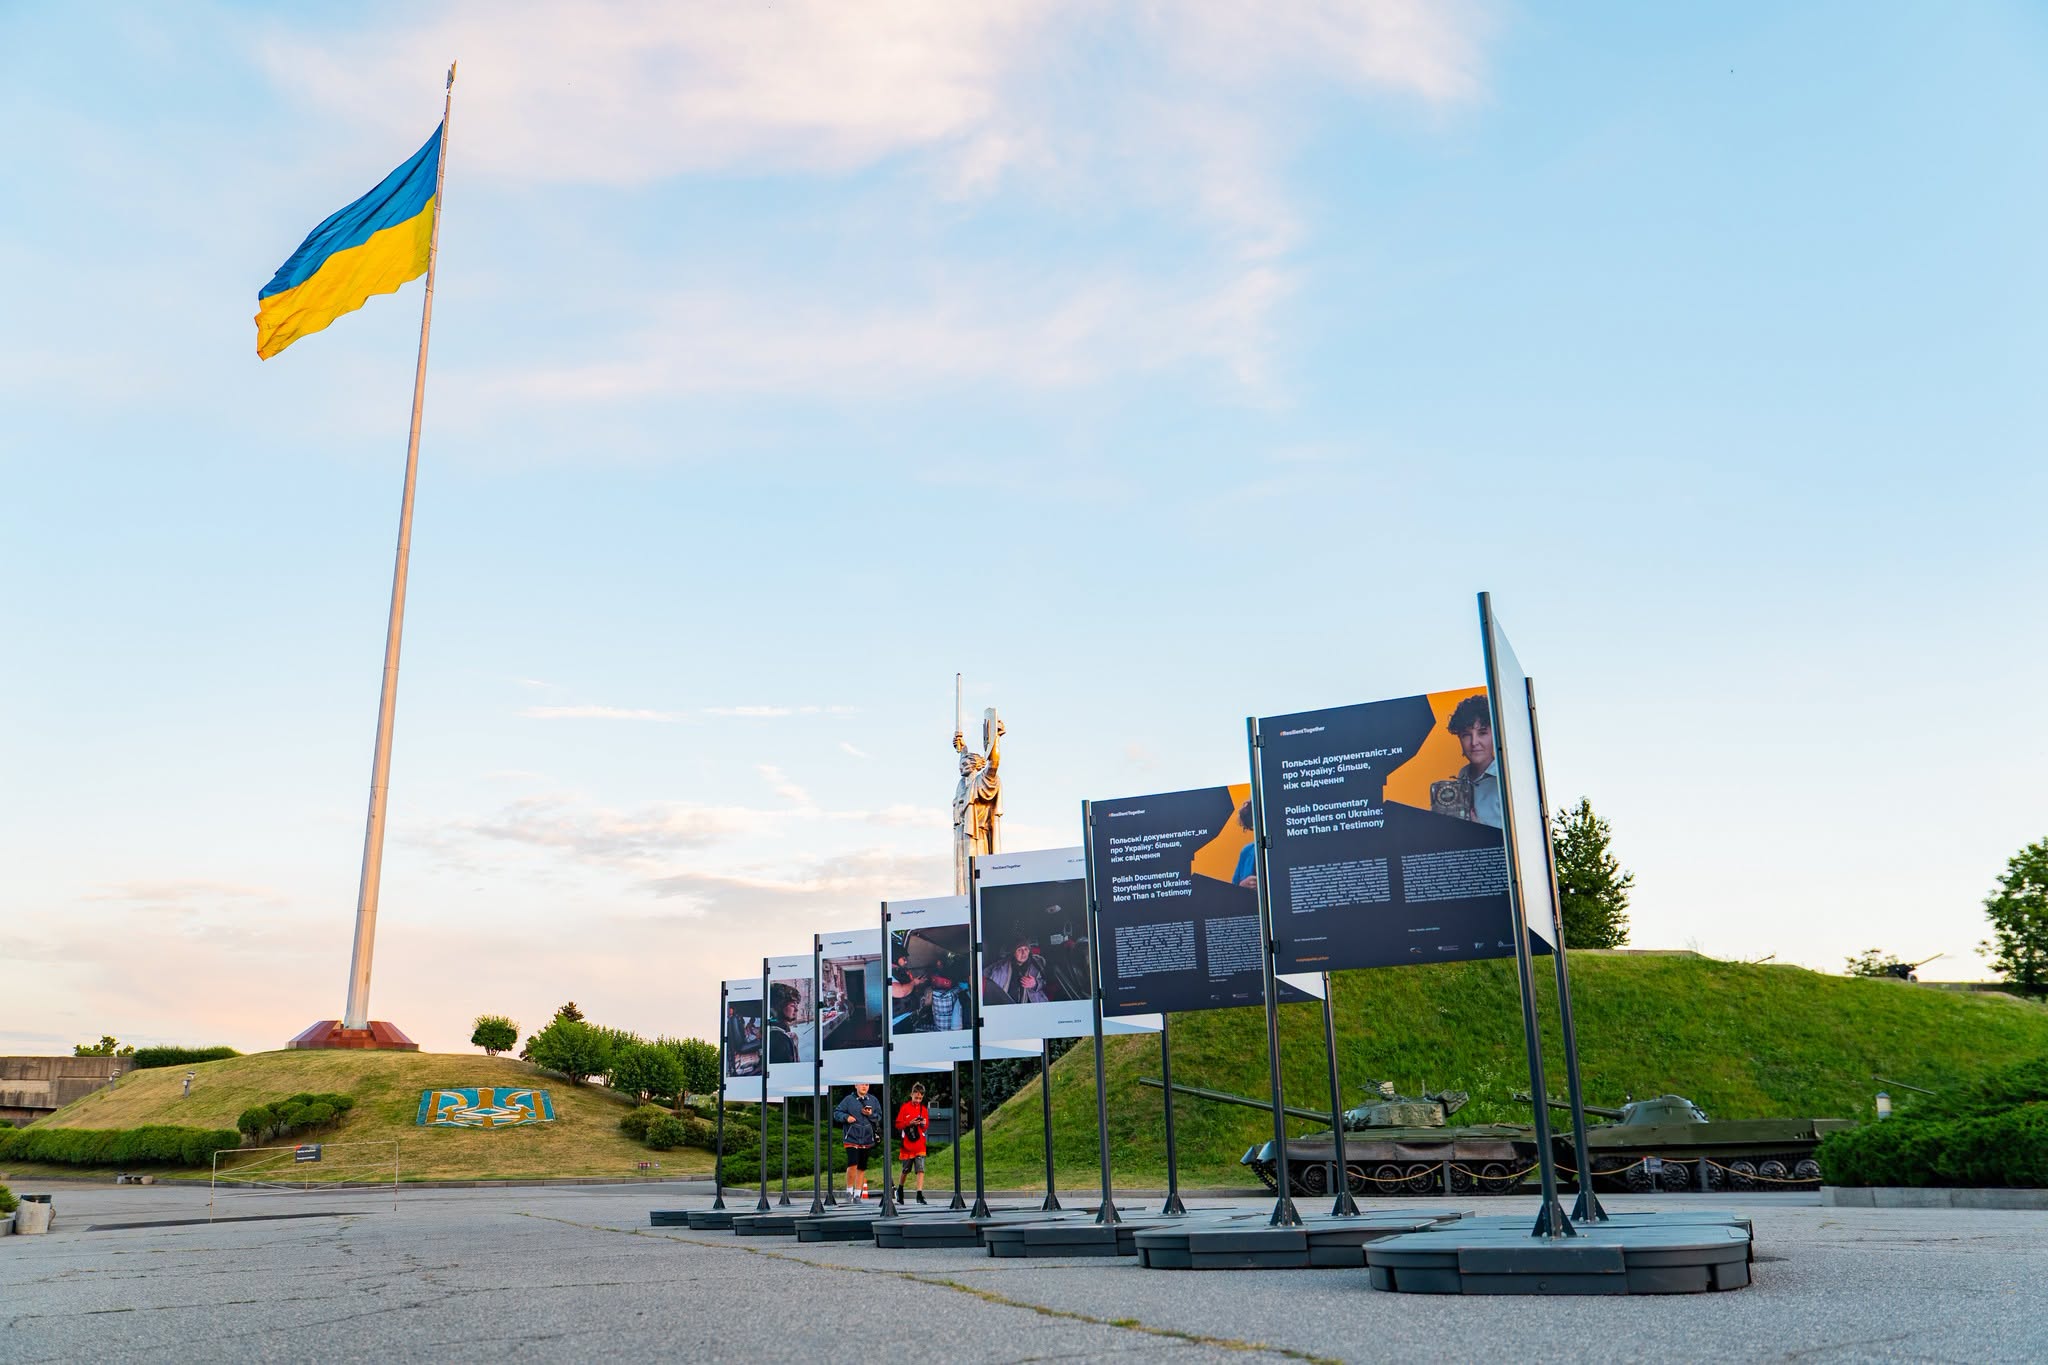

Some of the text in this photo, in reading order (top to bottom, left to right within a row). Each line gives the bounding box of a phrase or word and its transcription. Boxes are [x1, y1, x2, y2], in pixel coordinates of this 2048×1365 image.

[1282, 747, 1402, 768] Польські документаліст_ки
[1282, 762, 1371, 781] про Україну: більше,
[1283, 776, 1344, 790] ніж свідчення
[1285, 799, 1368, 815] Polish Documentary
[1286, 808, 1383, 826] Storytellers on Ukraine:
[1287, 827, 1308, 837] More
[1310, 824, 1331, 834] Than
[1340, 819, 1384, 830] Testimony
[1110, 829, 1208, 845] Польські документаліст_ки
[1124, 844, 1154, 853] Україну:
[1154, 841, 1182, 849] більше,
[1125, 852, 1160, 861] свідчення
[1112, 871, 1180, 883] Polish Documentary
[1113, 884, 1151, 893] Storytellers
[1162, 879, 1192, 888] Ukraine:
[1156, 889, 1192, 898] Testimony
